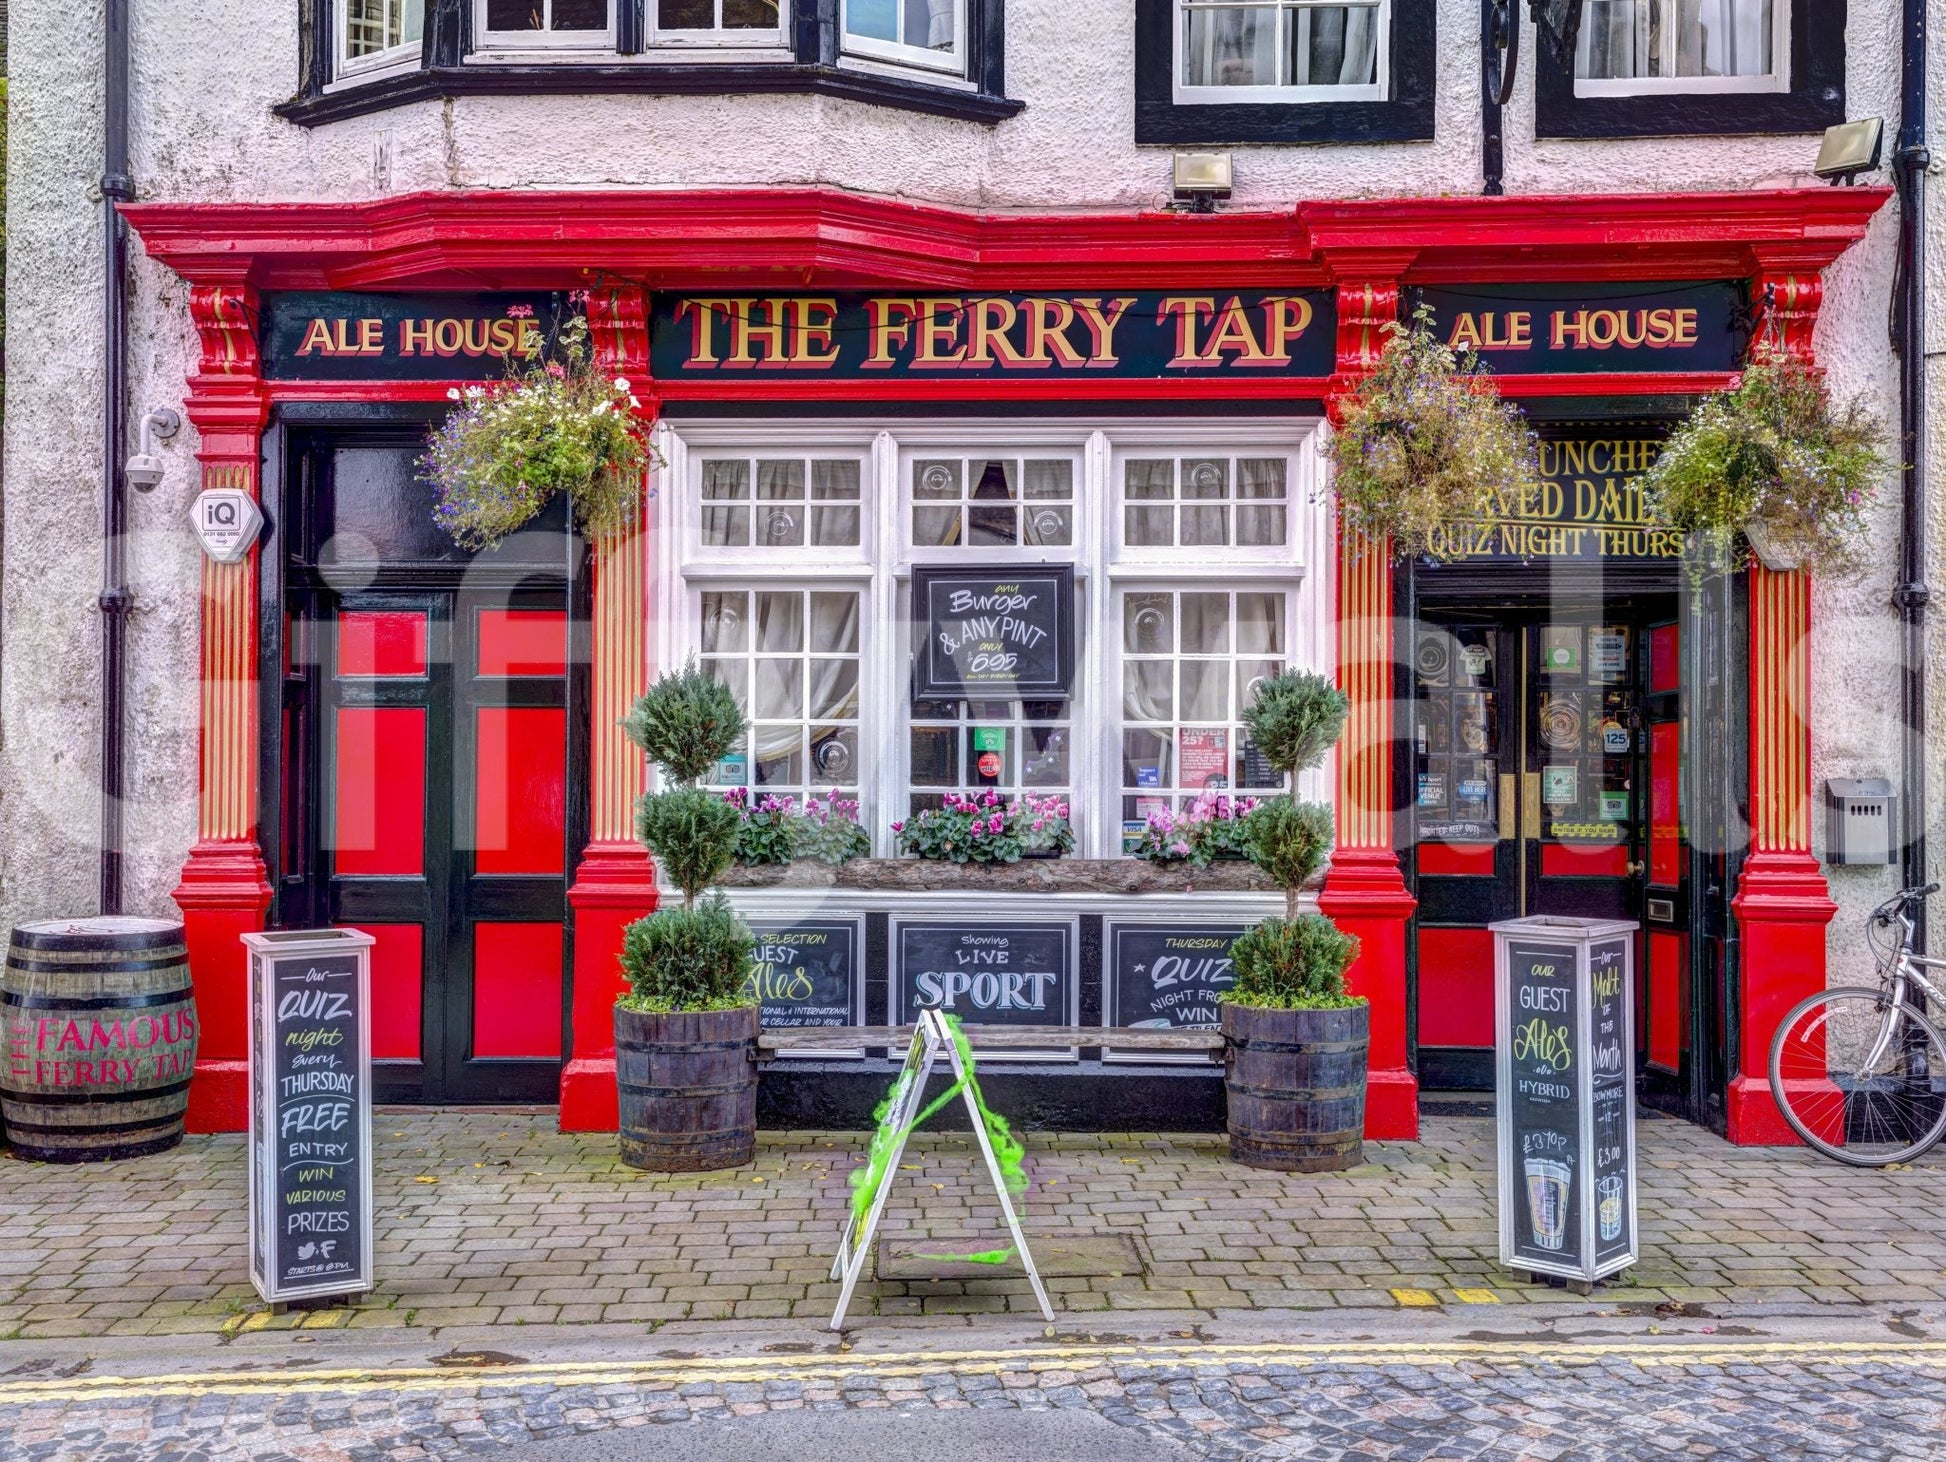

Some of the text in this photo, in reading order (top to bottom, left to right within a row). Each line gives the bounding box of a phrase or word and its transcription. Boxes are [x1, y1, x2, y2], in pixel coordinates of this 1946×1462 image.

[295, 318, 540, 357] ALE HOUSE
[674, 296, 1313, 369] THE FERRY TAP
[1448, 308, 1698, 351] ALE HOUSE
[1538, 439, 1662, 477] UNCHE
[1574, 477, 1658, 524] DAIL
[208, 502, 235, 525] iQ
[1427, 524, 1685, 558] QUIZ NIGHT THURS
[994, 584, 1020, 593] any
[949, 589, 1037, 615] Burger
[939, 616, 1047, 655] & ANY PINT
[1182, 735, 1204, 745] 25?
[1606, 733, 1626, 745] 125
[760, 933, 828, 944] SELECTION
[1165, 938, 1228, 949] THURSDAY
[955, 950, 1009, 965] LIVE
[305, 968, 329, 982] Our
[740, 962, 814, 1001] Ales
[1151, 956, 1233, 990] QUIZ
[1531, 964, 1555, 977] OUR
[913, 971, 1057, 1010] SPORT
[1520, 985, 1571, 1013] GUEST
[1592, 966, 1620, 1009] Malt
[278, 990, 352, 1023] QUIZ
[794, 1007, 849, 1016] INTERNATIONAL
[1150, 989, 1224, 1012] NIGHT FRO
[770, 1018, 802, 1026] CELLAR
[804, 1018, 821, 1026] AND
[823, 1018, 843, 1026] YOUR
[1176, 1007, 1217, 1022] WIN
[1601, 1020, 1613, 1034] THE
[37, 1007, 196, 1051] FAMOUS
[285, 1027, 344, 1052] night
[10, 1015, 31, 1081] THE
[1592, 1038, 1621, 1072] Month
[35, 1050, 192, 1087] FERRY TAP
[281, 1072, 354, 1097] THURSDAY
[1519, 1080, 1570, 1099] HYBRID
[1593, 1085, 1623, 1102] BOWMORE
[281, 1103, 350, 1138] FREE
[289, 1142, 348, 1157] ENTRY
[299, 1166, 334, 1183] WIN
[286, 1190, 346, 1205] VARIOUS
[288, 1211, 350, 1235] PRIZES
